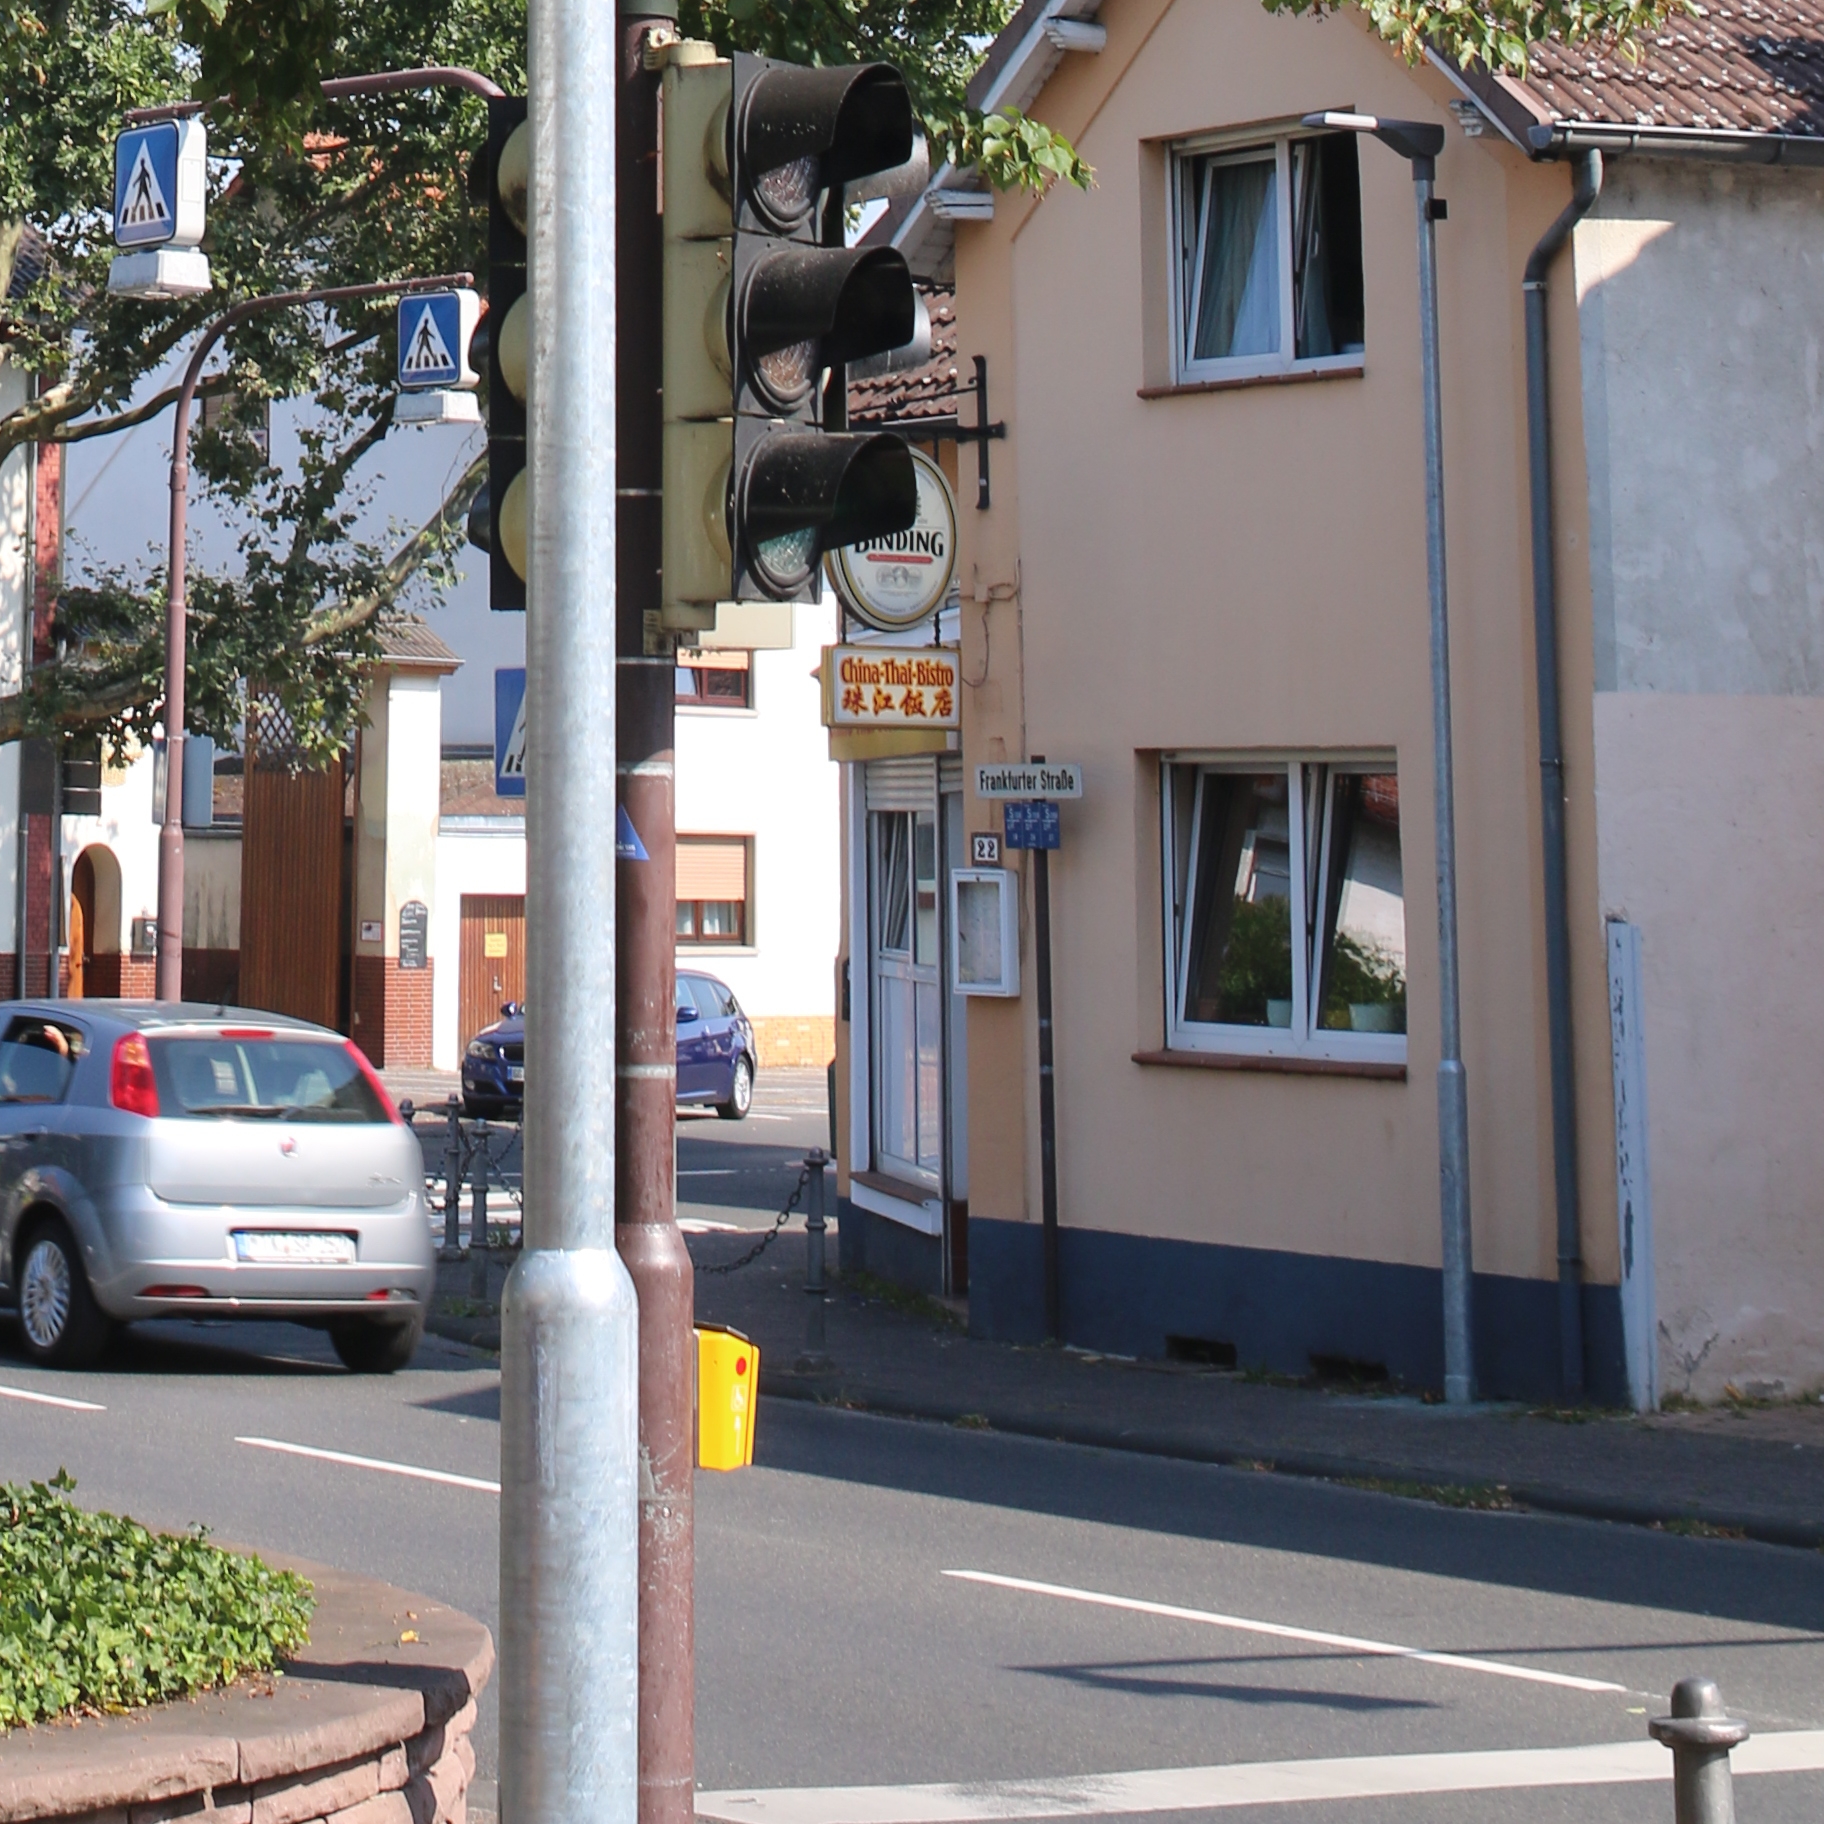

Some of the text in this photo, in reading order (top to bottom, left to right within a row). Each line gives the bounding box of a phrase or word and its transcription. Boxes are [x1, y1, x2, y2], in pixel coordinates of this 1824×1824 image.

[979, 769, 1075, 791] Frankfurter Straße
[977, 839, 996, 859] 22
